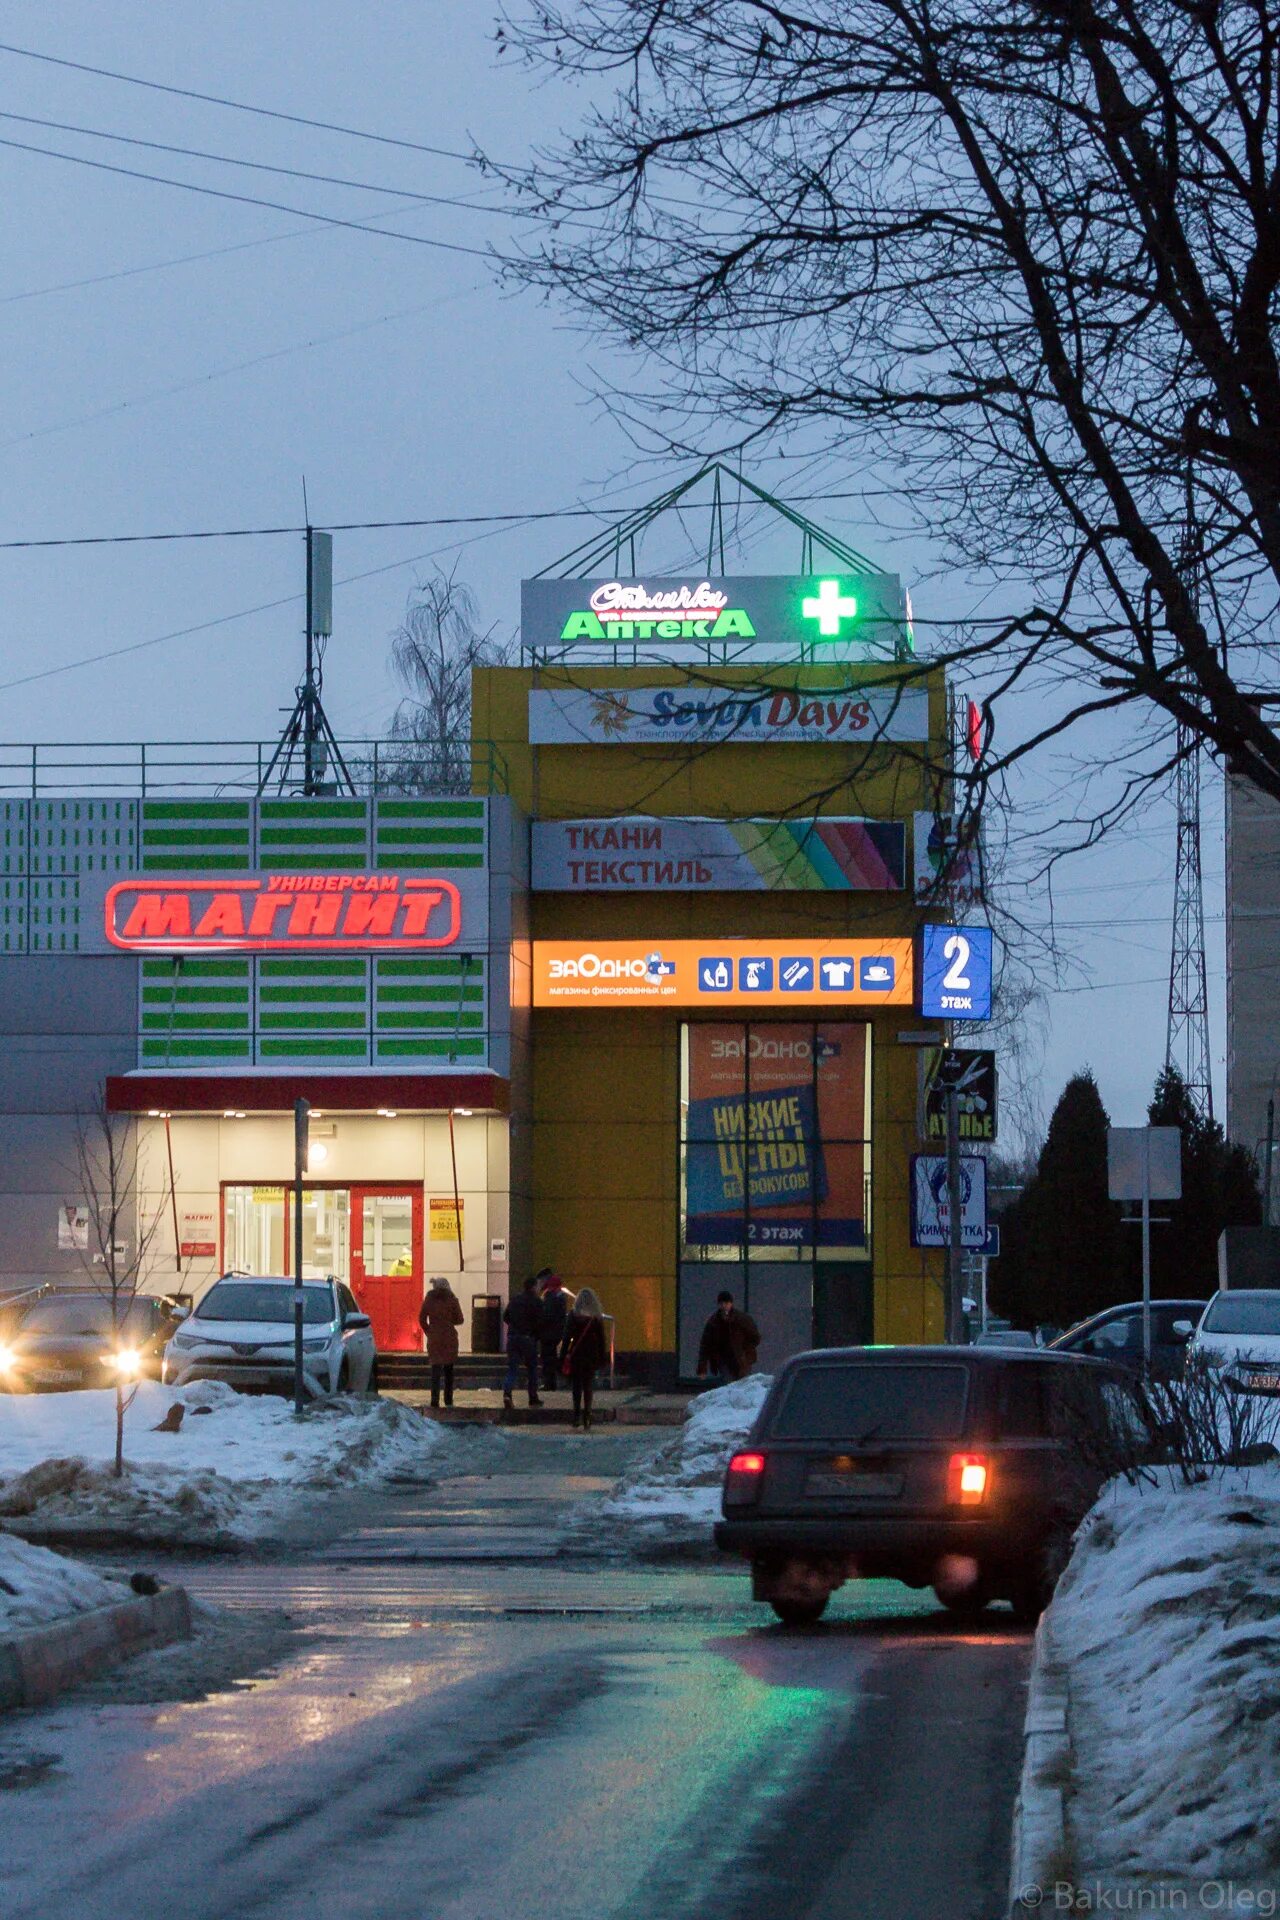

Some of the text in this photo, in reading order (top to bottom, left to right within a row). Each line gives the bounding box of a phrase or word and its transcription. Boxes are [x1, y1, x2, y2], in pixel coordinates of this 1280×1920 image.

[767, 690, 870, 735] Days
[565, 827, 662, 849] ТКАНИ
[268, 876, 398, 891] УНИВЕРСАМ
[567, 860, 713, 884] ТЕКСТИЛЬ
[123, 893, 442, 936] МАГНИТ
[943, 935, 971, 989] 2
[549, 986, 676, 996] магазины фиксированных цен
[941, 996, 972, 1009] этаж
[950, 1052, 956, 1061] 2
[713, 1096, 802, 1136] НИЗКИЕ
[929, 1112, 993, 1137] АТЛЬЕ
[717, 1125, 807, 1179] ЦЕНЫ
[749, 1225, 804, 1240] 2 этаж
[919, 1224, 984, 1237] ХИМЧТКА
